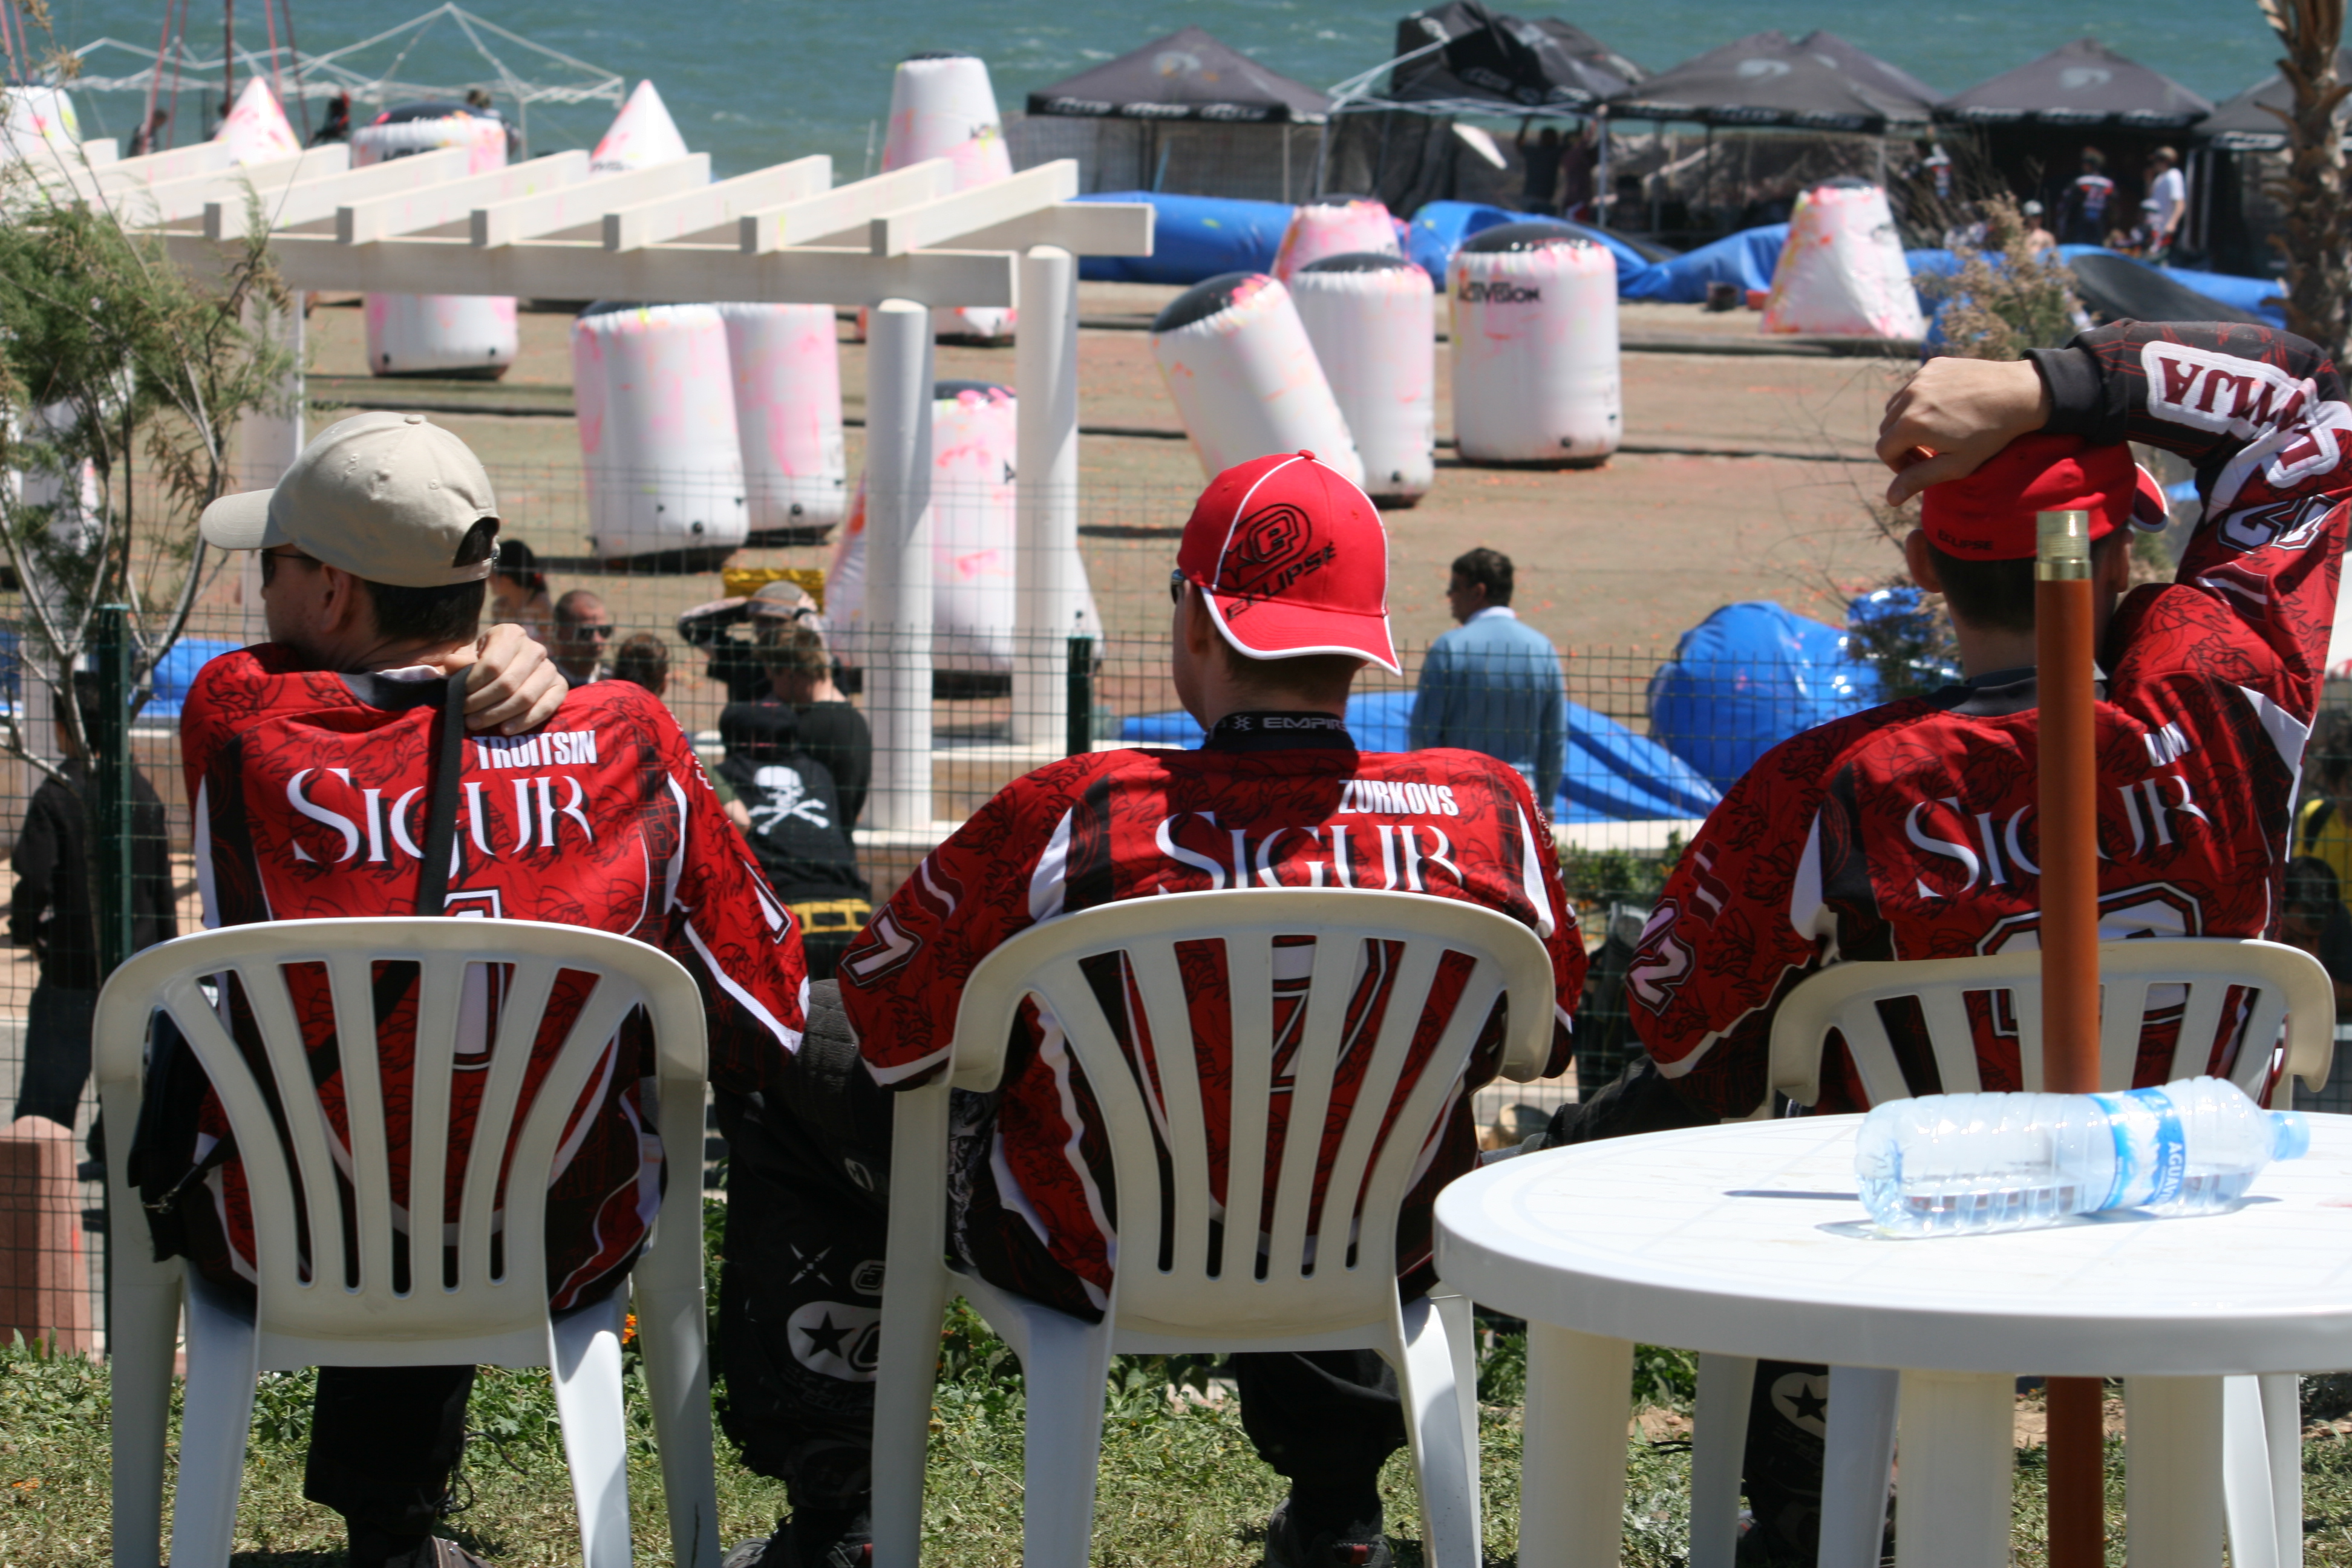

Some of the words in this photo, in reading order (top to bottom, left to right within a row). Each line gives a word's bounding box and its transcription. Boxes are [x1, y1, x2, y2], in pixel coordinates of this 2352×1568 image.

[1937, 529, 1994, 550] ECLIPSE
[1226, 541, 1336, 621] ECLIPSE
[472, 730, 597, 769] TROITSIN
[1338, 780, 1459, 815] ZURKOVS
[1155, 811, 1465, 895] SIGUR
[841, 904, 923, 985] 7
